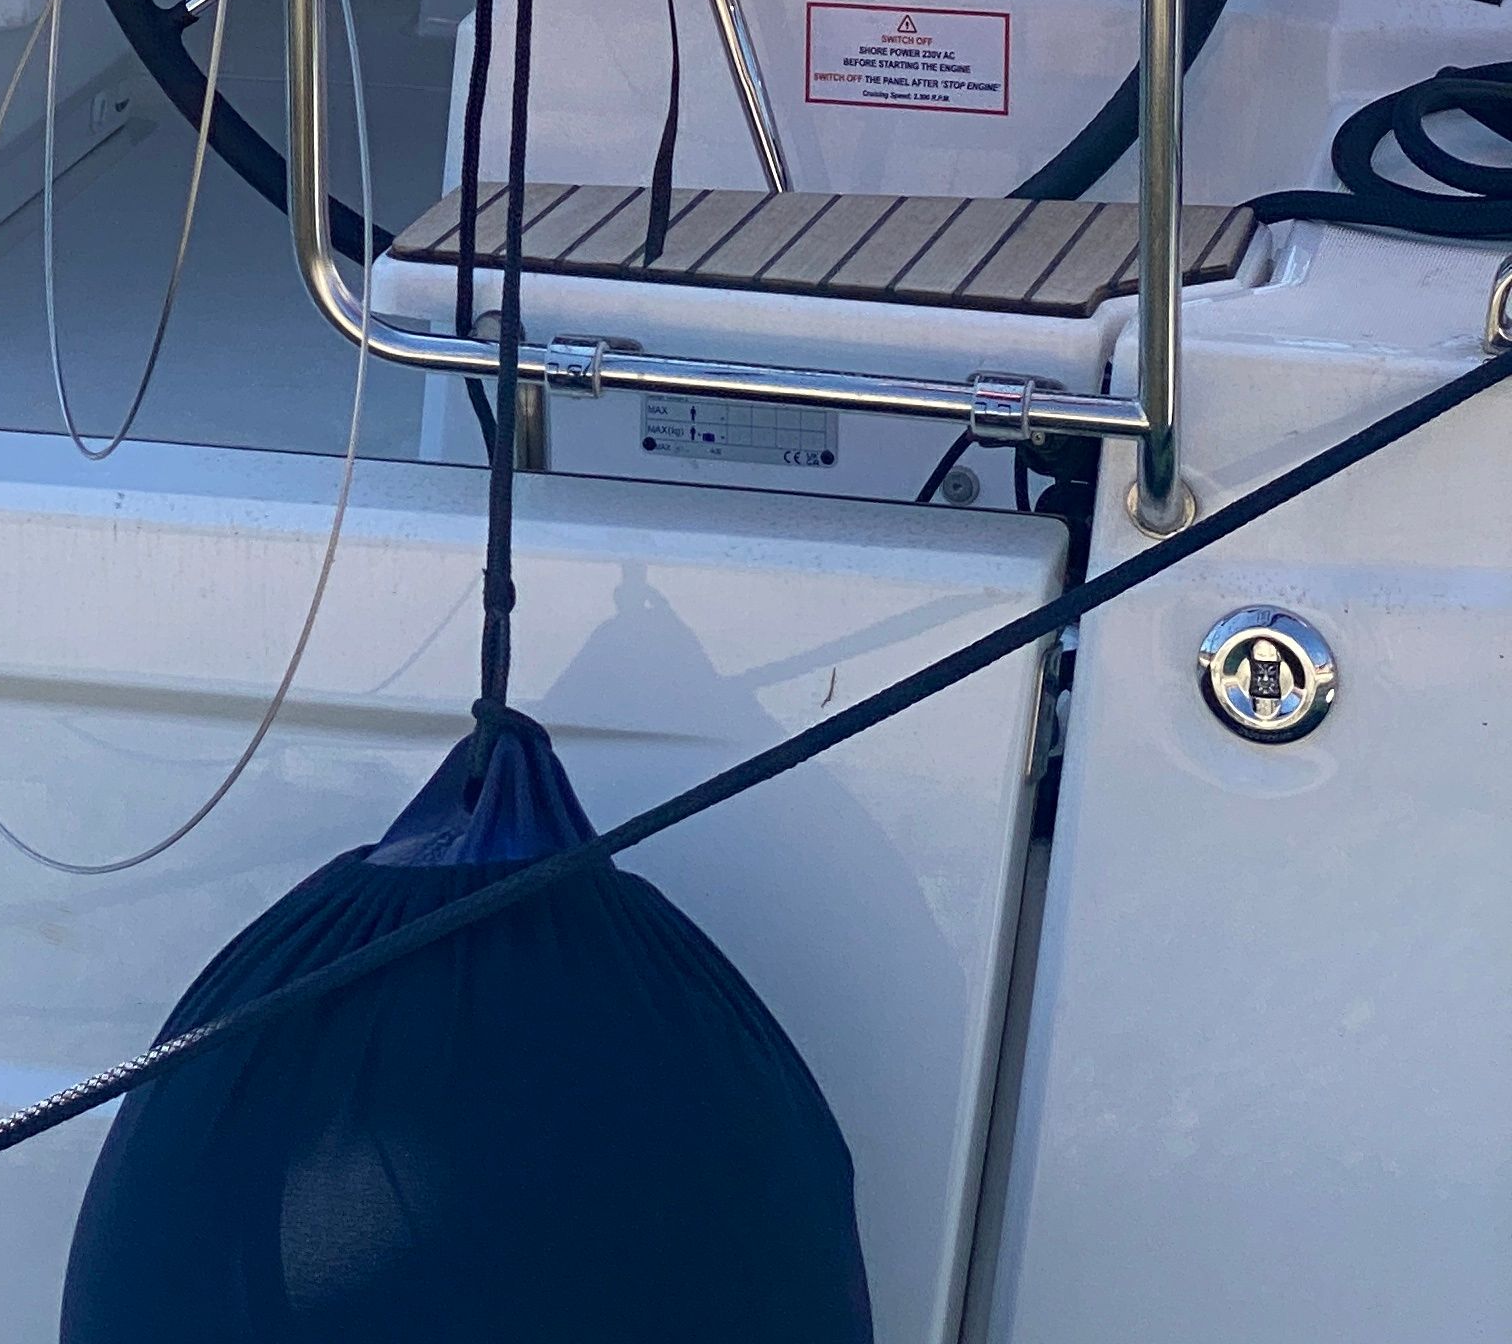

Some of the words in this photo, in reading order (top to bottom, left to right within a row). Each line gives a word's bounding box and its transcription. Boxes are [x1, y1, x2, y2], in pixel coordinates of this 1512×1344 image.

[881, 34, 914, 45] SWITCH
[916, 37, 933, 46] OFF
[859, 46, 887, 56] SHORE
[890, 48, 920, 58] POWER
[943, 51, 955, 60] AC
[843, 58, 876, 67] BEFORE
[879, 60, 919, 70] STARTING
[921, 62, 937, 72] THE
[939, 64, 971, 73] ENGINE
[814, 73, 844, 82] SWITCH
[846, 74, 862, 82] OFF
[865, 75, 881, 84] THE
[883, 77, 909, 86] PANEL
[911, 78, 938, 88] AFTER
[863, 90, 888, 99] Cruising
